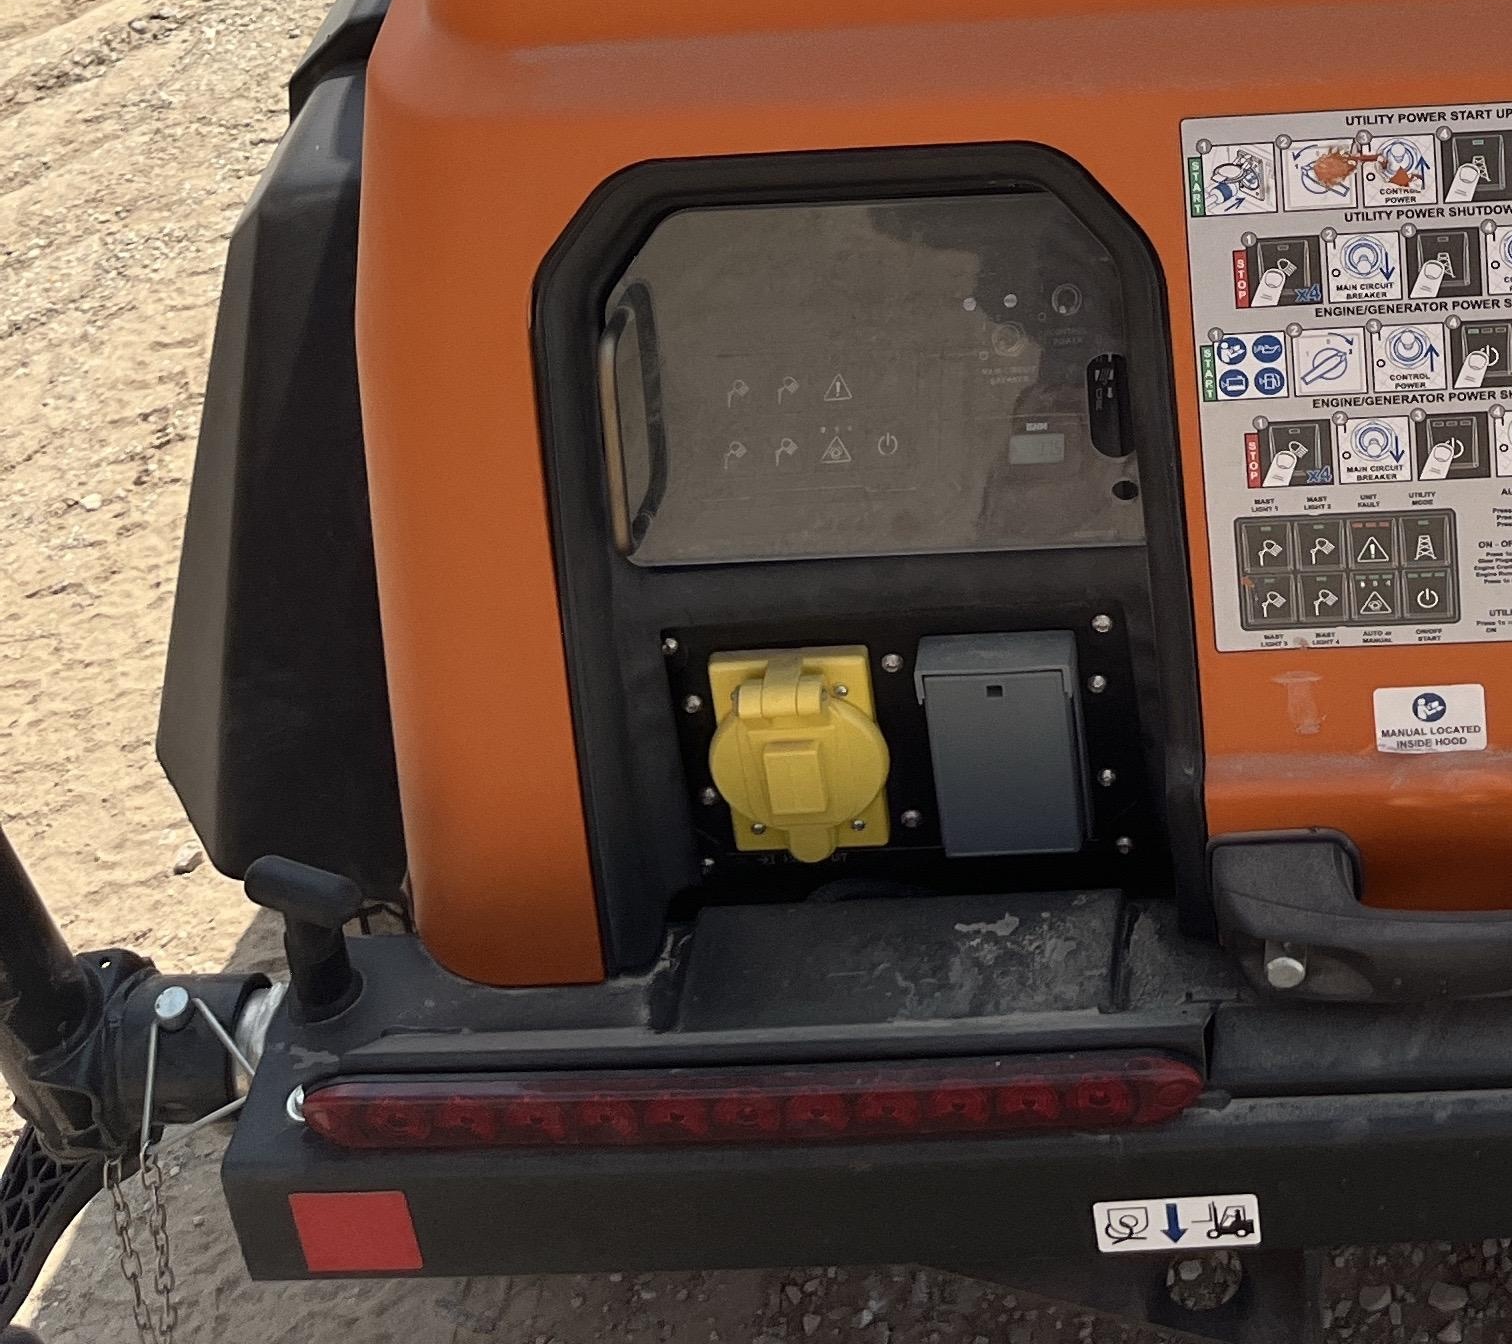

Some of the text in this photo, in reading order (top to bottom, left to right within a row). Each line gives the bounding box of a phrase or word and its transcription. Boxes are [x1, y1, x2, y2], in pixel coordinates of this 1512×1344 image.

[1345, 108, 1512, 125] UTILITY POWER START UP
[1192, 161, 1203, 216] START
[1384, 195, 1418, 203] POWER
[1344, 209, 1392, 222] UTILITY
[1396, 207, 1445, 219] POWER
[1237, 258, 1247, 299] STOP
[1335, 281, 1393, 291] MAIN CIRCUIT
[1346, 291, 1387, 299] BREAKER
[1314, 301, 1448, 317] ENGINE/GENERATOR
[1451, 298, 1500, 310] POWER
[1203, 349, 1213, 398] START
[1389, 373, 1430, 381] CONTROL
[1394, 381, 1426, 389] POWER
[1312, 392, 1444, 408] ENGINE/GENERATOR
[1448, 390, 1496, 401] POWER
[1249, 441, 1258, 481] STOP
[1369, 464, 1402, 472] CIRCUIT
[1478, 540, 1492, 548] ON
[1381, 724, 1480, 737] MANUAL LOCATED
[1396, 736, 1467, 749] INSIDE HOOD
